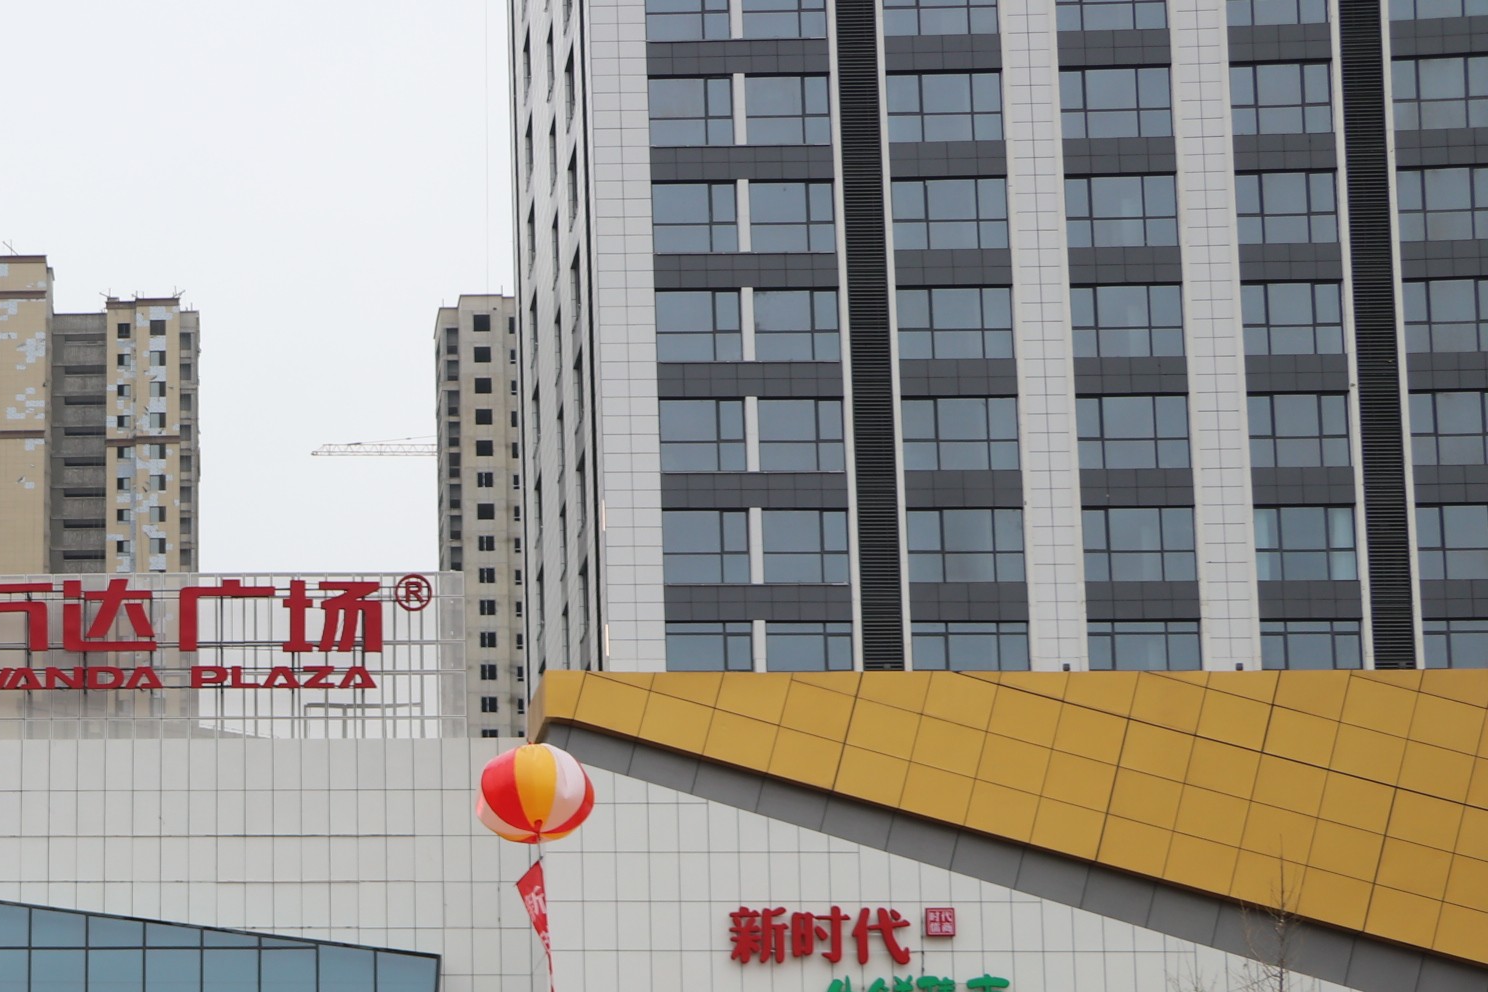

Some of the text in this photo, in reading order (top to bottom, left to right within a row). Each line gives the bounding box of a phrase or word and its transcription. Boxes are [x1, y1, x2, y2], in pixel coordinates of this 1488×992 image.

[191, 665, 378, 690] PLAZA
[729, 906, 911, 965] 新时代
